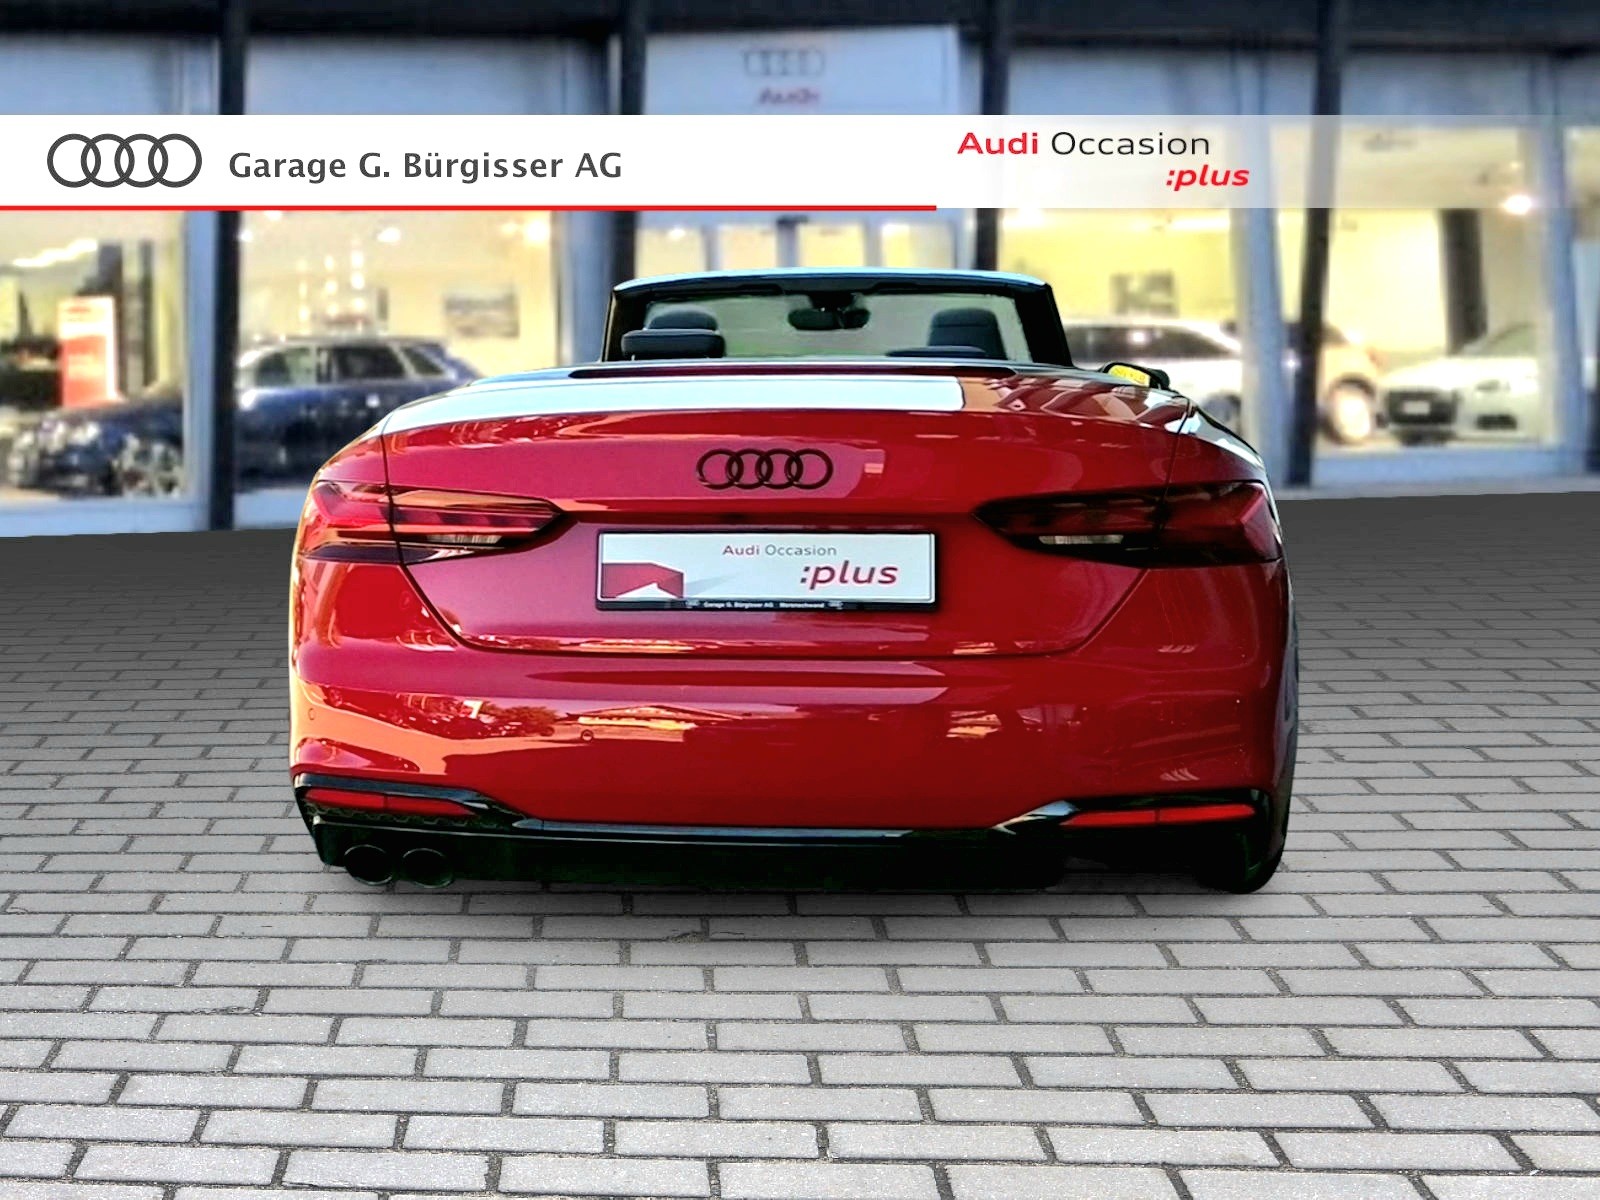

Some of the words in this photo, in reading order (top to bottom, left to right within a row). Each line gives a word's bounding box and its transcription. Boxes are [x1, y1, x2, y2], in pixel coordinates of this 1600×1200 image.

[721, 544, 760, 556] Audi
[764, 543, 838, 557] Occasion
[800, 559, 899, 590] :plus
